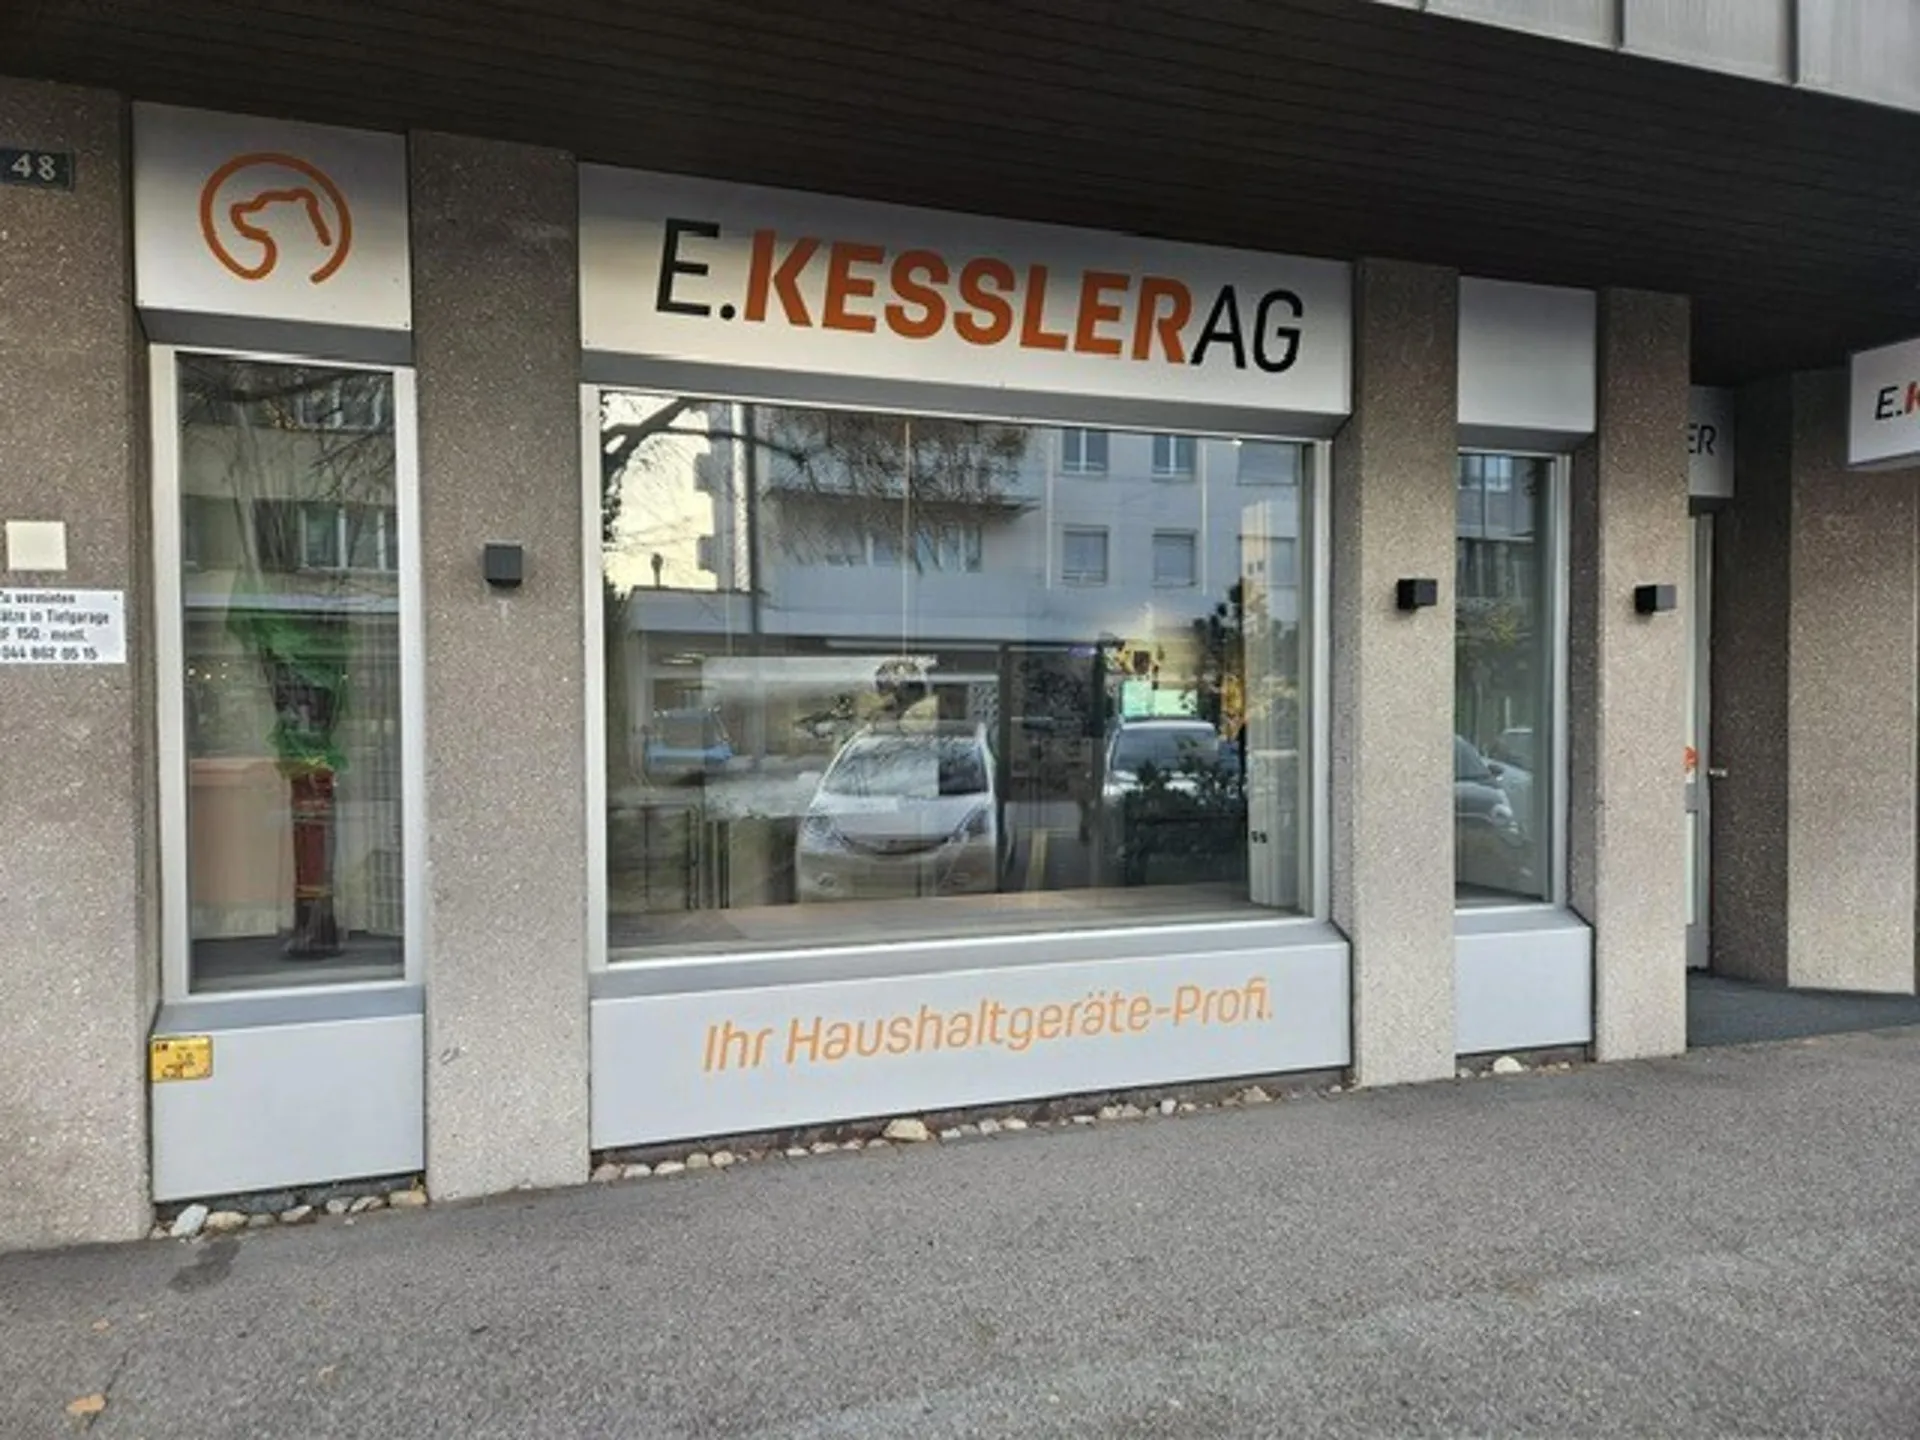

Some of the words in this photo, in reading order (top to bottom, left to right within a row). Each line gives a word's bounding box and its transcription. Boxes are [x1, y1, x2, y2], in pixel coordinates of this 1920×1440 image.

[11, 152, 56, 181] 48
[703, 1020, 773, 1072] Ihr
[785, 977, 1273, 1063] Haushaltgeräte-Profi.
